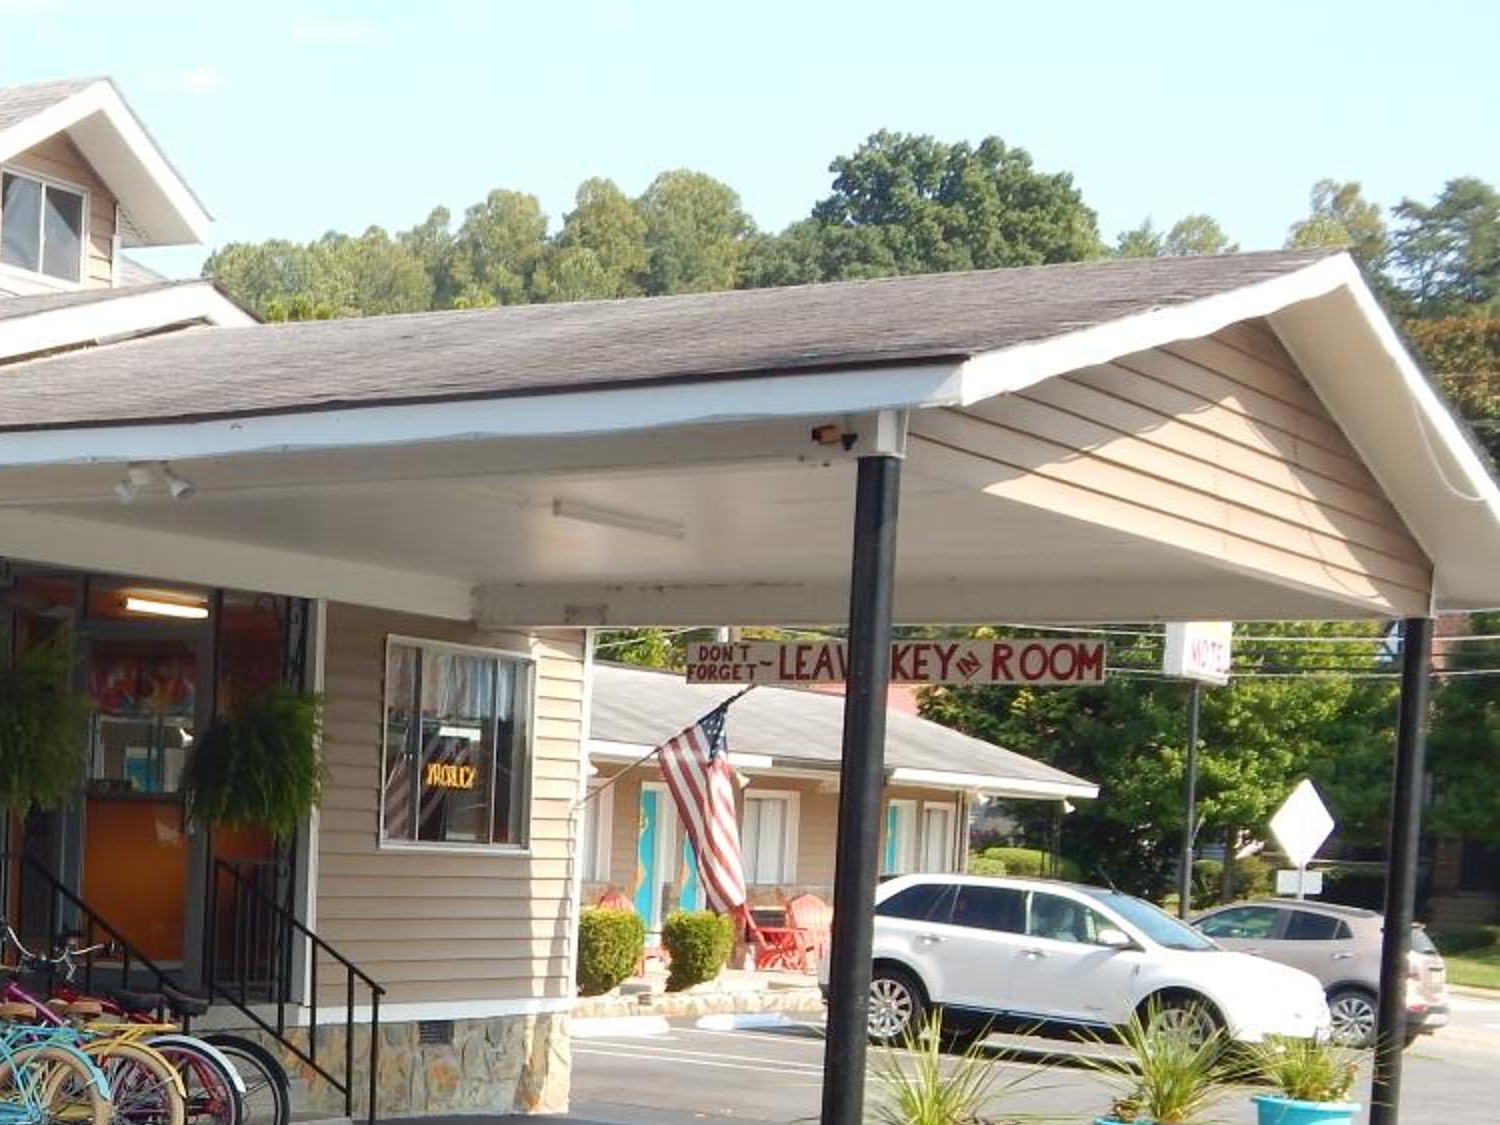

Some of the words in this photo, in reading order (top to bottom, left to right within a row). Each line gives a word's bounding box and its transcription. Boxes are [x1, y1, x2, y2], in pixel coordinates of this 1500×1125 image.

[698, 642, 750, 662] DON'T
[779, 643, 849, 681] LEAV
[891, 643, 959, 681] KEY
[956, 651, 982, 678] IN
[991, 643, 1105, 681] ROOM
[687, 664, 757, 681] FORGET
